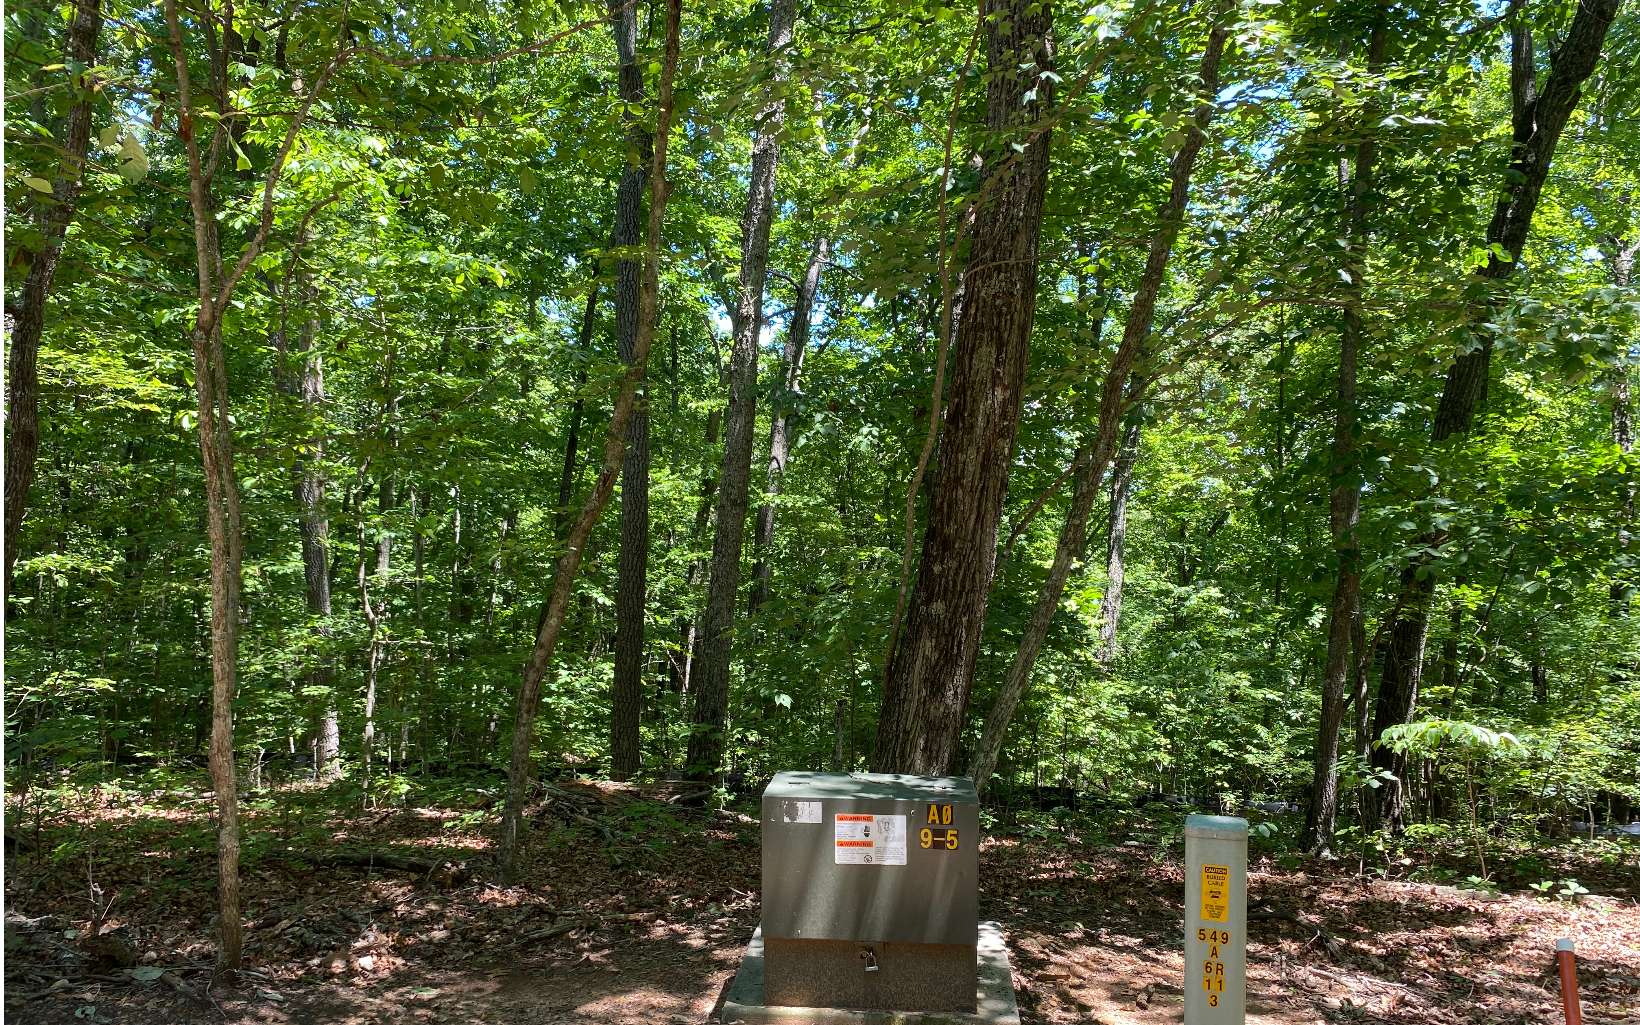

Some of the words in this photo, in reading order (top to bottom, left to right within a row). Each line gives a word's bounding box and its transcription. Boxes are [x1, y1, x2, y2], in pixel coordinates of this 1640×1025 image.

[920, 828, 958, 849] 9-5
[1211, 946, 1218, 958] A
[1209, 995, 1218, 1007] 3
